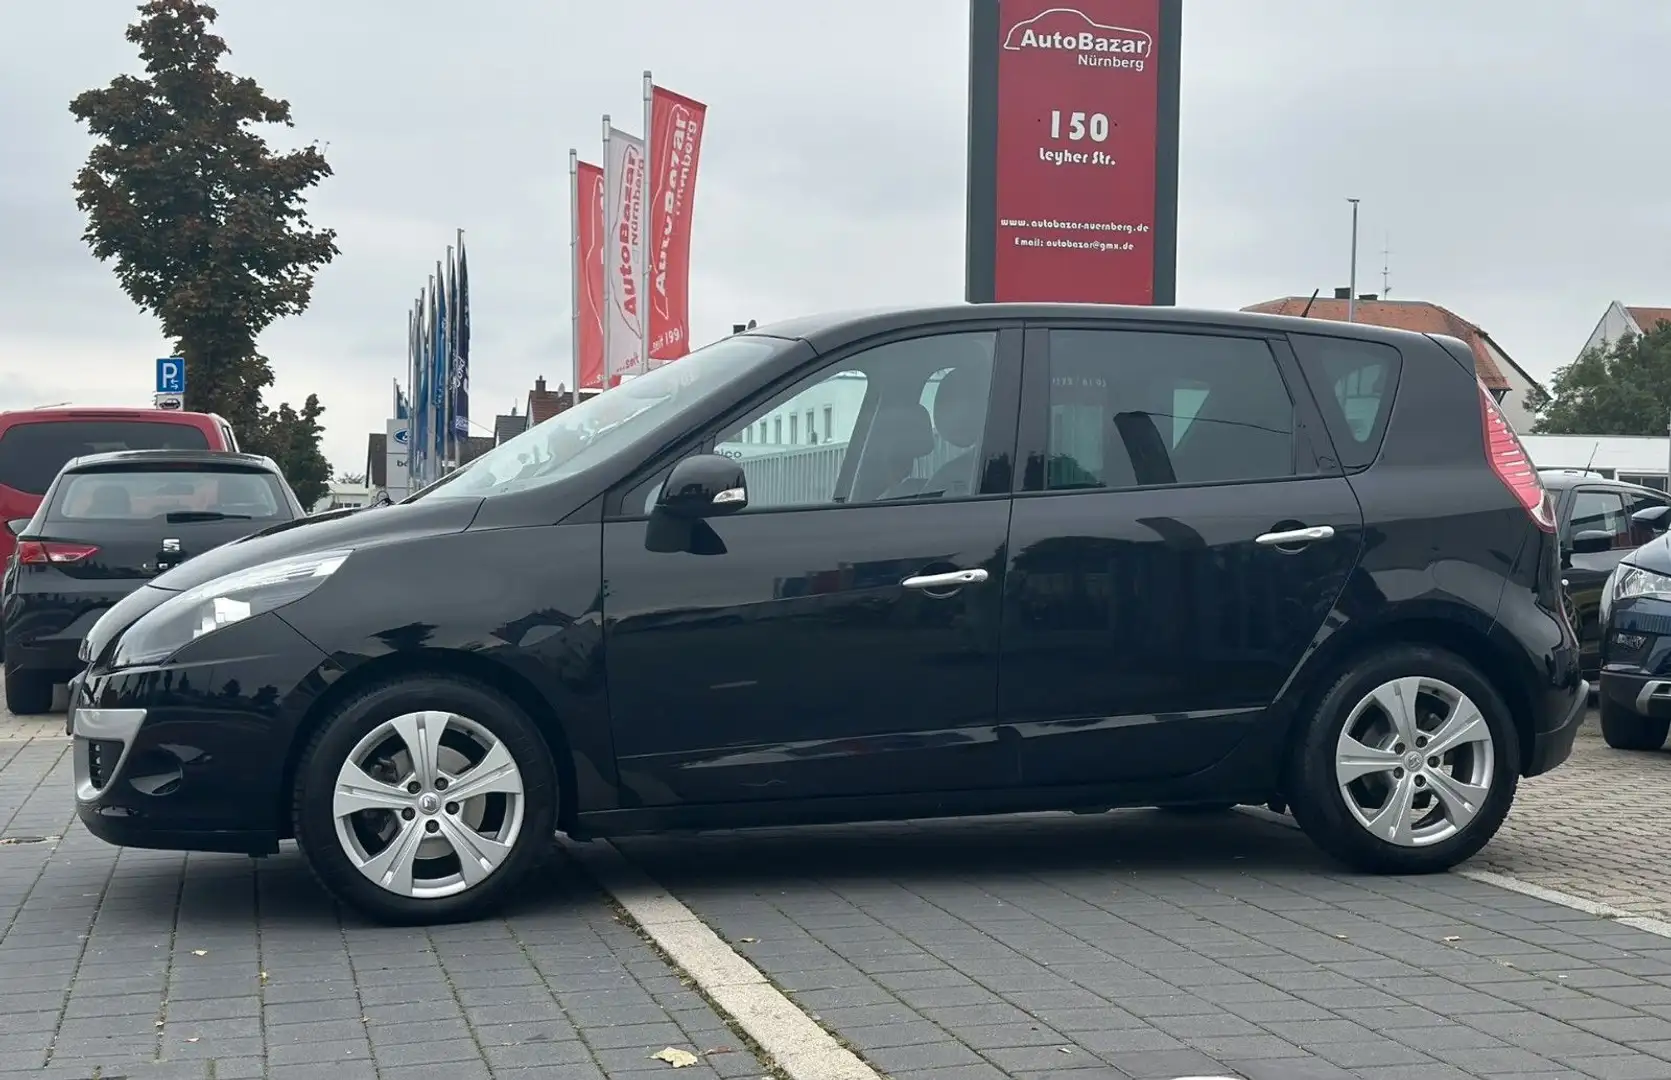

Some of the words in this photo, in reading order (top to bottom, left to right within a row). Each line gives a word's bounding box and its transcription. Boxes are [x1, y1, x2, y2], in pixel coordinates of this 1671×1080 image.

[1020, 29, 1147, 54] AutoBazar
[1078, 54, 1144, 72] Nürnberg
[1051, 110, 1109, 142] 150
[1092, 151, 1116, 166] Str.
[619, 151, 637, 316] AutoBazar
[1000, 218, 1149, 234] www.autobazar-nuernberg.de
[1046, 240, 1135, 251] autobazar@gmx.de
[162, 362, 178, 388] P
